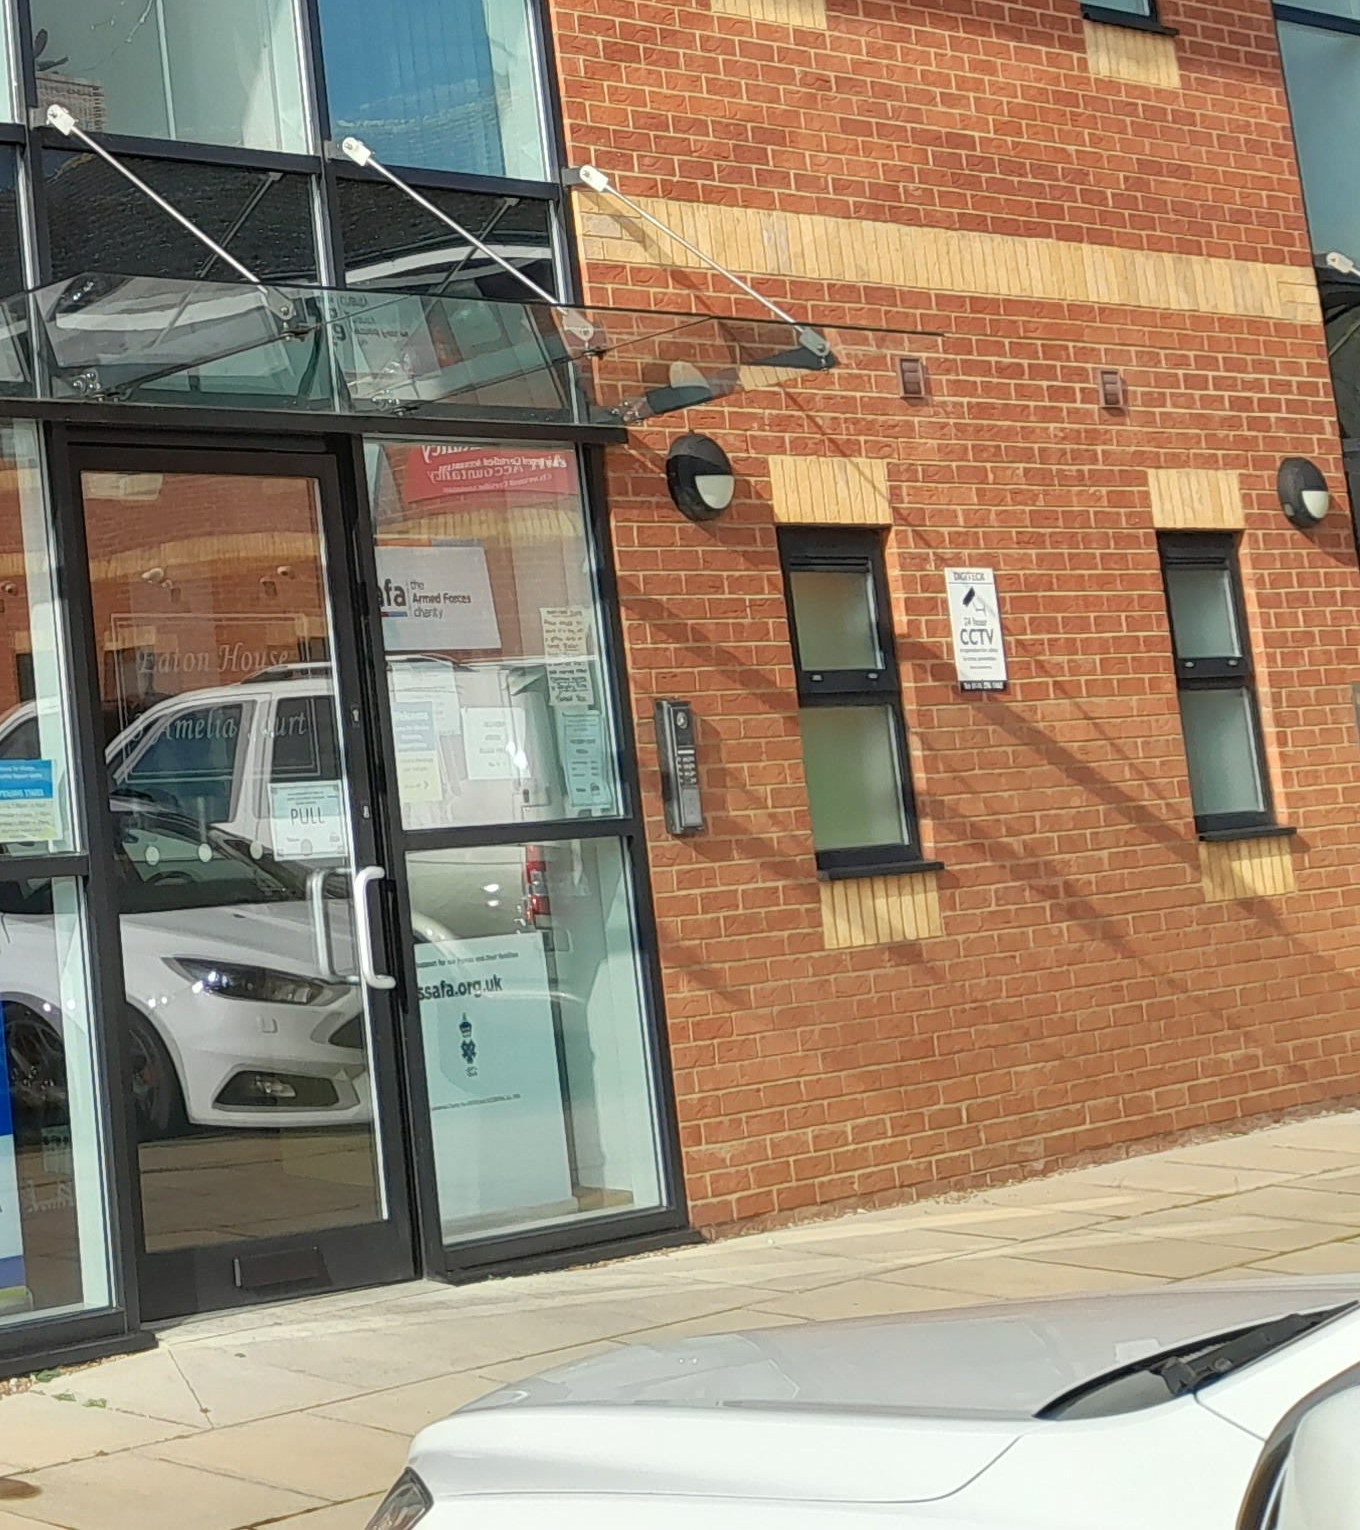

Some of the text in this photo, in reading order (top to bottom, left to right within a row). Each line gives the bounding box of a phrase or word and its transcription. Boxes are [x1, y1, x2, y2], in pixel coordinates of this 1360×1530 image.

[960, 628, 994, 645] CCTV
[217, 642, 288, 671] House
[291, 806, 325, 825] PULL
